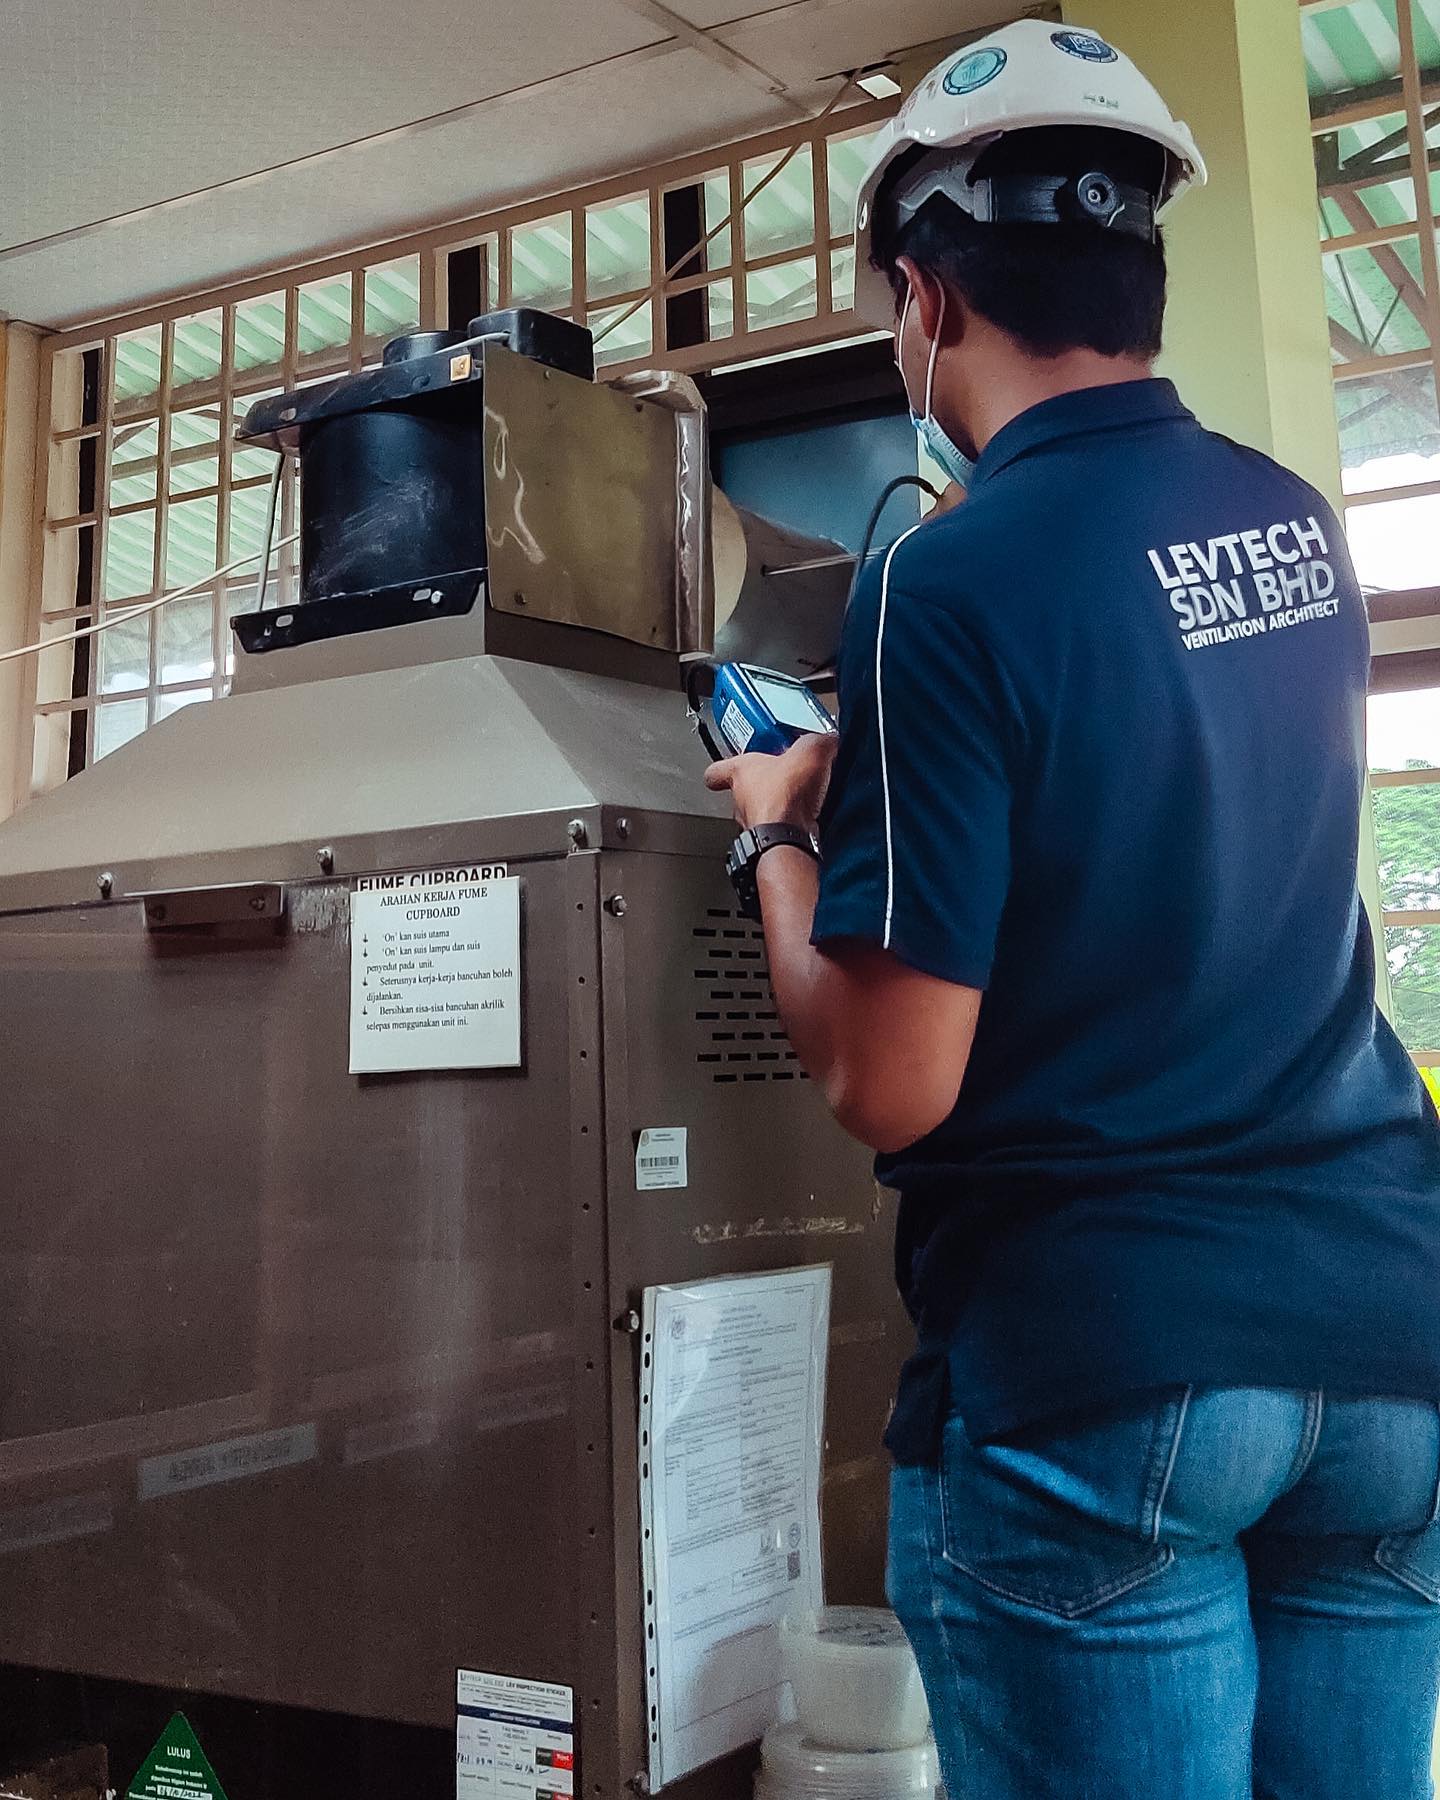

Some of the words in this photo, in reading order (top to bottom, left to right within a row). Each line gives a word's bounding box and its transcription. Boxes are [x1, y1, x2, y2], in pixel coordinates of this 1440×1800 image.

[1147, 516, 1329, 590] LEVTECH
[1169, 578, 1248, 631] SDN
[1253, 560, 1335, 613] BHD
[1181, 616, 1266, 651] VENTILATION
[1268, 598, 1340, 631] ARCHITECT
[380, 893, 421, 907] ARAHAN
[423, 890, 456, 903] KERJA
[458, 887, 488, 900] FUME
[406, 906, 461, 921] CUPBOARD
[399, 931, 412, 941] kan
[413, 930, 427, 940] suis
[428, 930, 450, 939] utama
[399, 946, 412, 956] kan
[413, 946, 427, 955] suis
[429, 943, 451, 955] lampu
[452, 942, 465, 952] dan
[466, 940, 480, 950] suis
[366, 961, 397, 975] penyedut
[399, 960, 415, 973] pada
[380, 975, 417, 987] Seterusnya
[418, 972, 456, 986] kerja-kerja
[457, 969, 491, 981] bancuhan
[492, 967, 513, 979] boleh
[379, 1004, 414, 1016] Bersihkan
[415, 1002, 444, 1014] sisa-sisa
[445, 1001, 479, 1012] bancuhan
[366, 1020, 391, 1033] selepas
[392, 1018, 440, 1031] menggunakan
[441, 1016, 455, 1027] unit
[167, 1745, 191, 1760] LULUS
